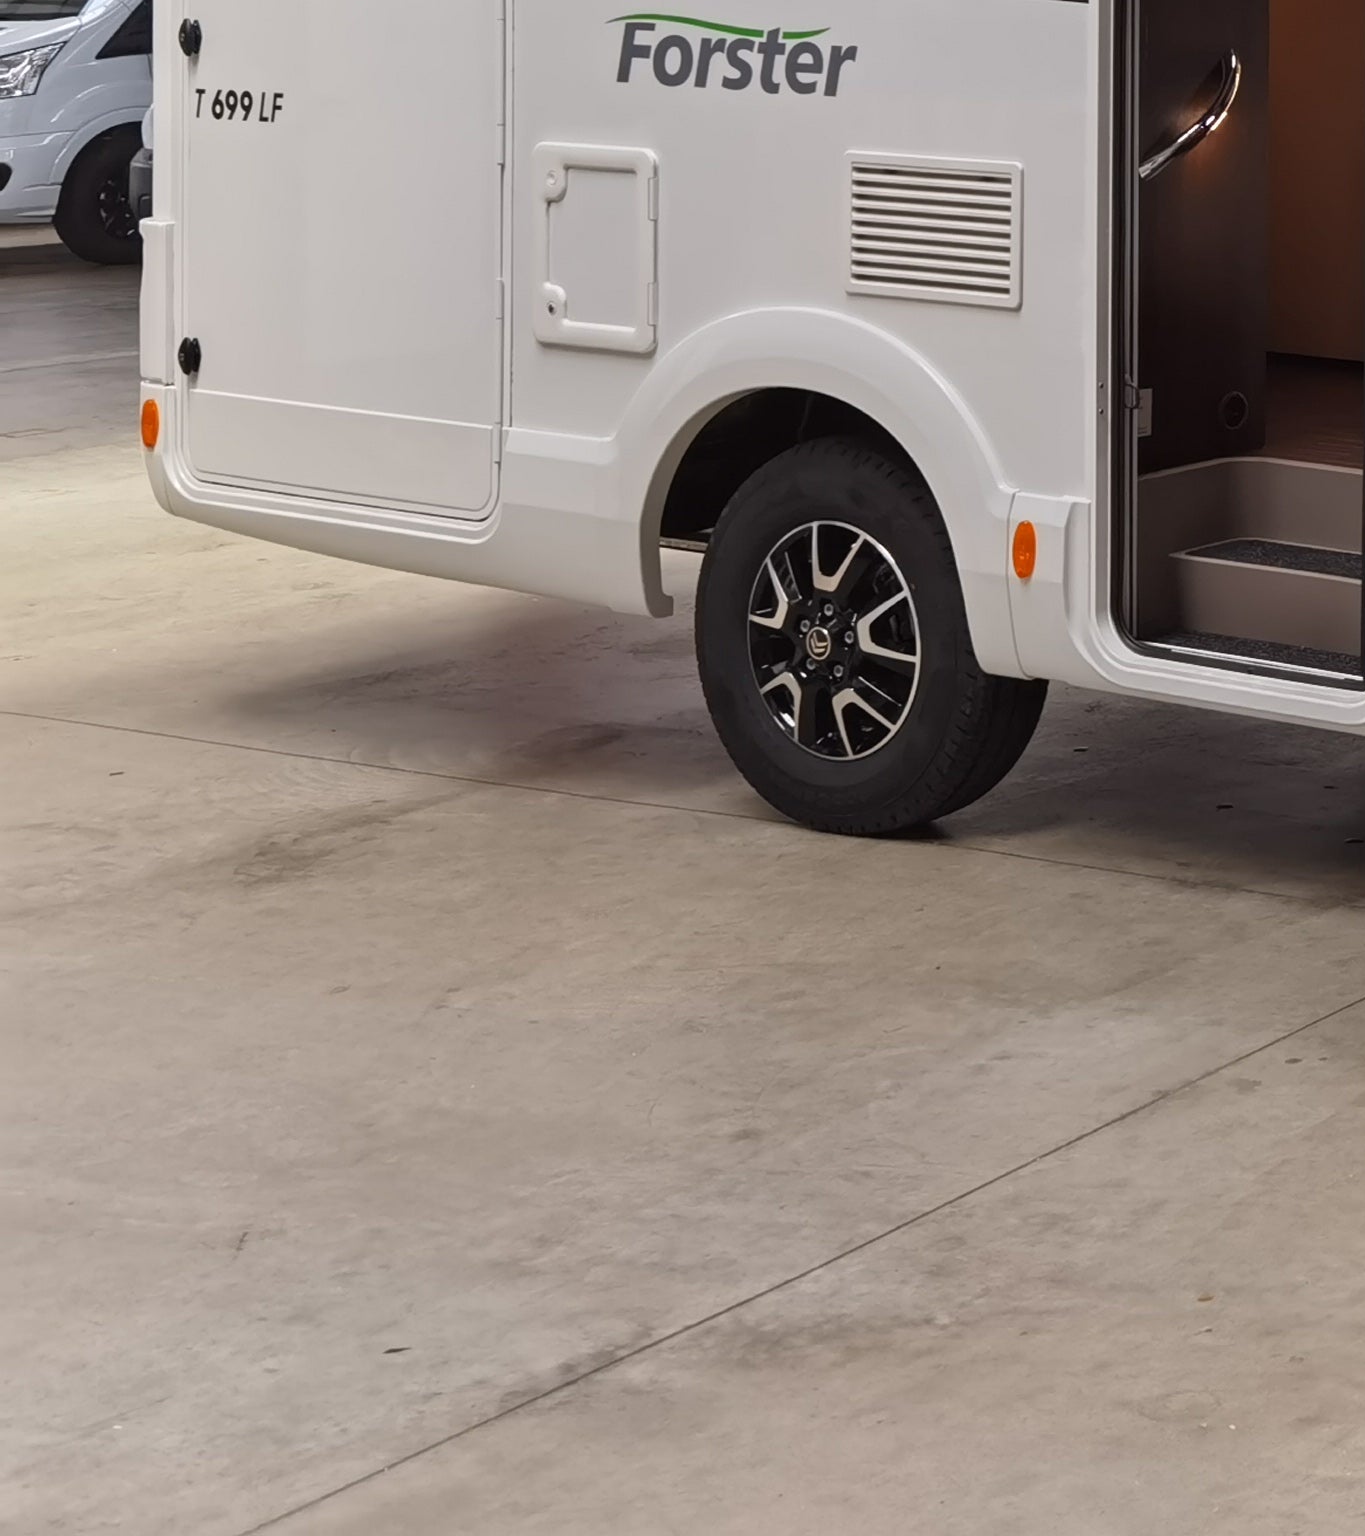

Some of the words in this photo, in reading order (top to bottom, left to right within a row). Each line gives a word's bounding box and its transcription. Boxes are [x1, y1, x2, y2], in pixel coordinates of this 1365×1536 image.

[616, 21, 858, 97] Forster
[195, 88, 206, 118] T
[211, 89, 253, 121] 699
[259, 91, 284, 123] LF
